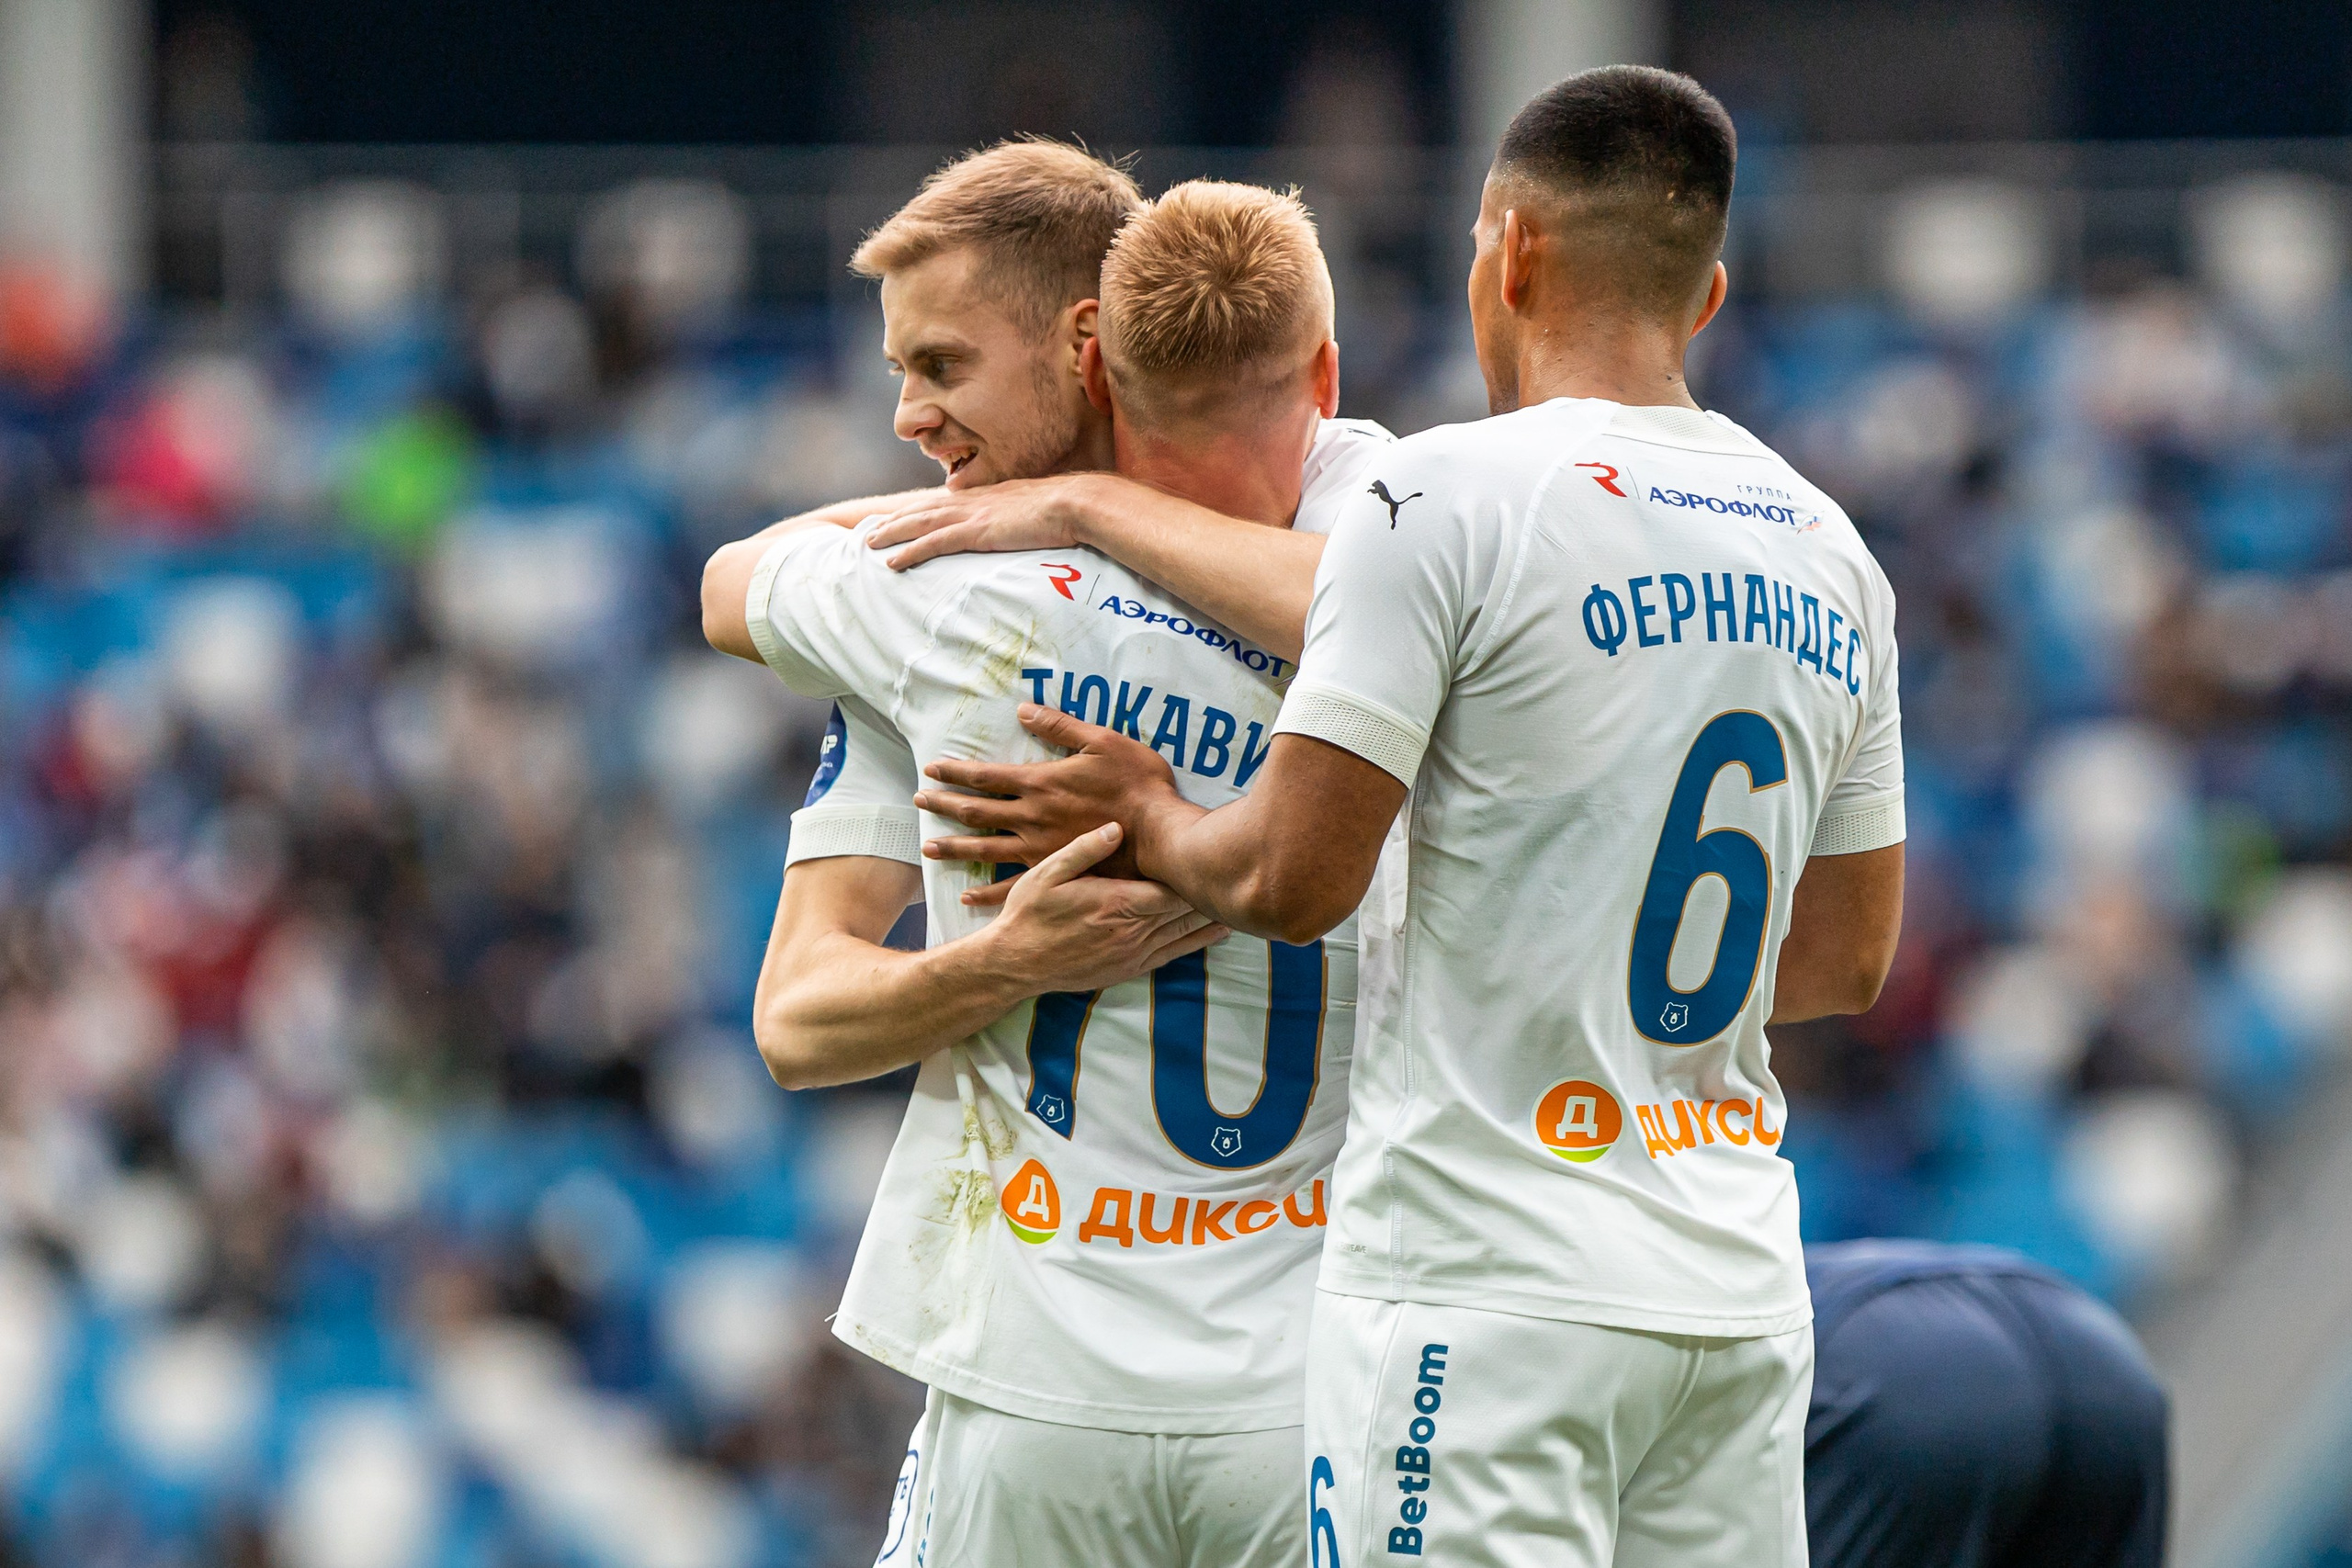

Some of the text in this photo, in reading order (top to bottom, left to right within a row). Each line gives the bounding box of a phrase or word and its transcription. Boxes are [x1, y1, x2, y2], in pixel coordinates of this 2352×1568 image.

[1649, 486, 1796, 526] АЭРОФЛОТ
[1736, 484, 1792, 502] ГРУППА
[1098, 595, 1290, 678] АЭРОФЛОТ
[1581, 571, 1862, 696] ФЕРНАНДЕС
[1627, 708, 1789, 1048] 6
[1387, 1343, 1449, 1556] BetBoom
